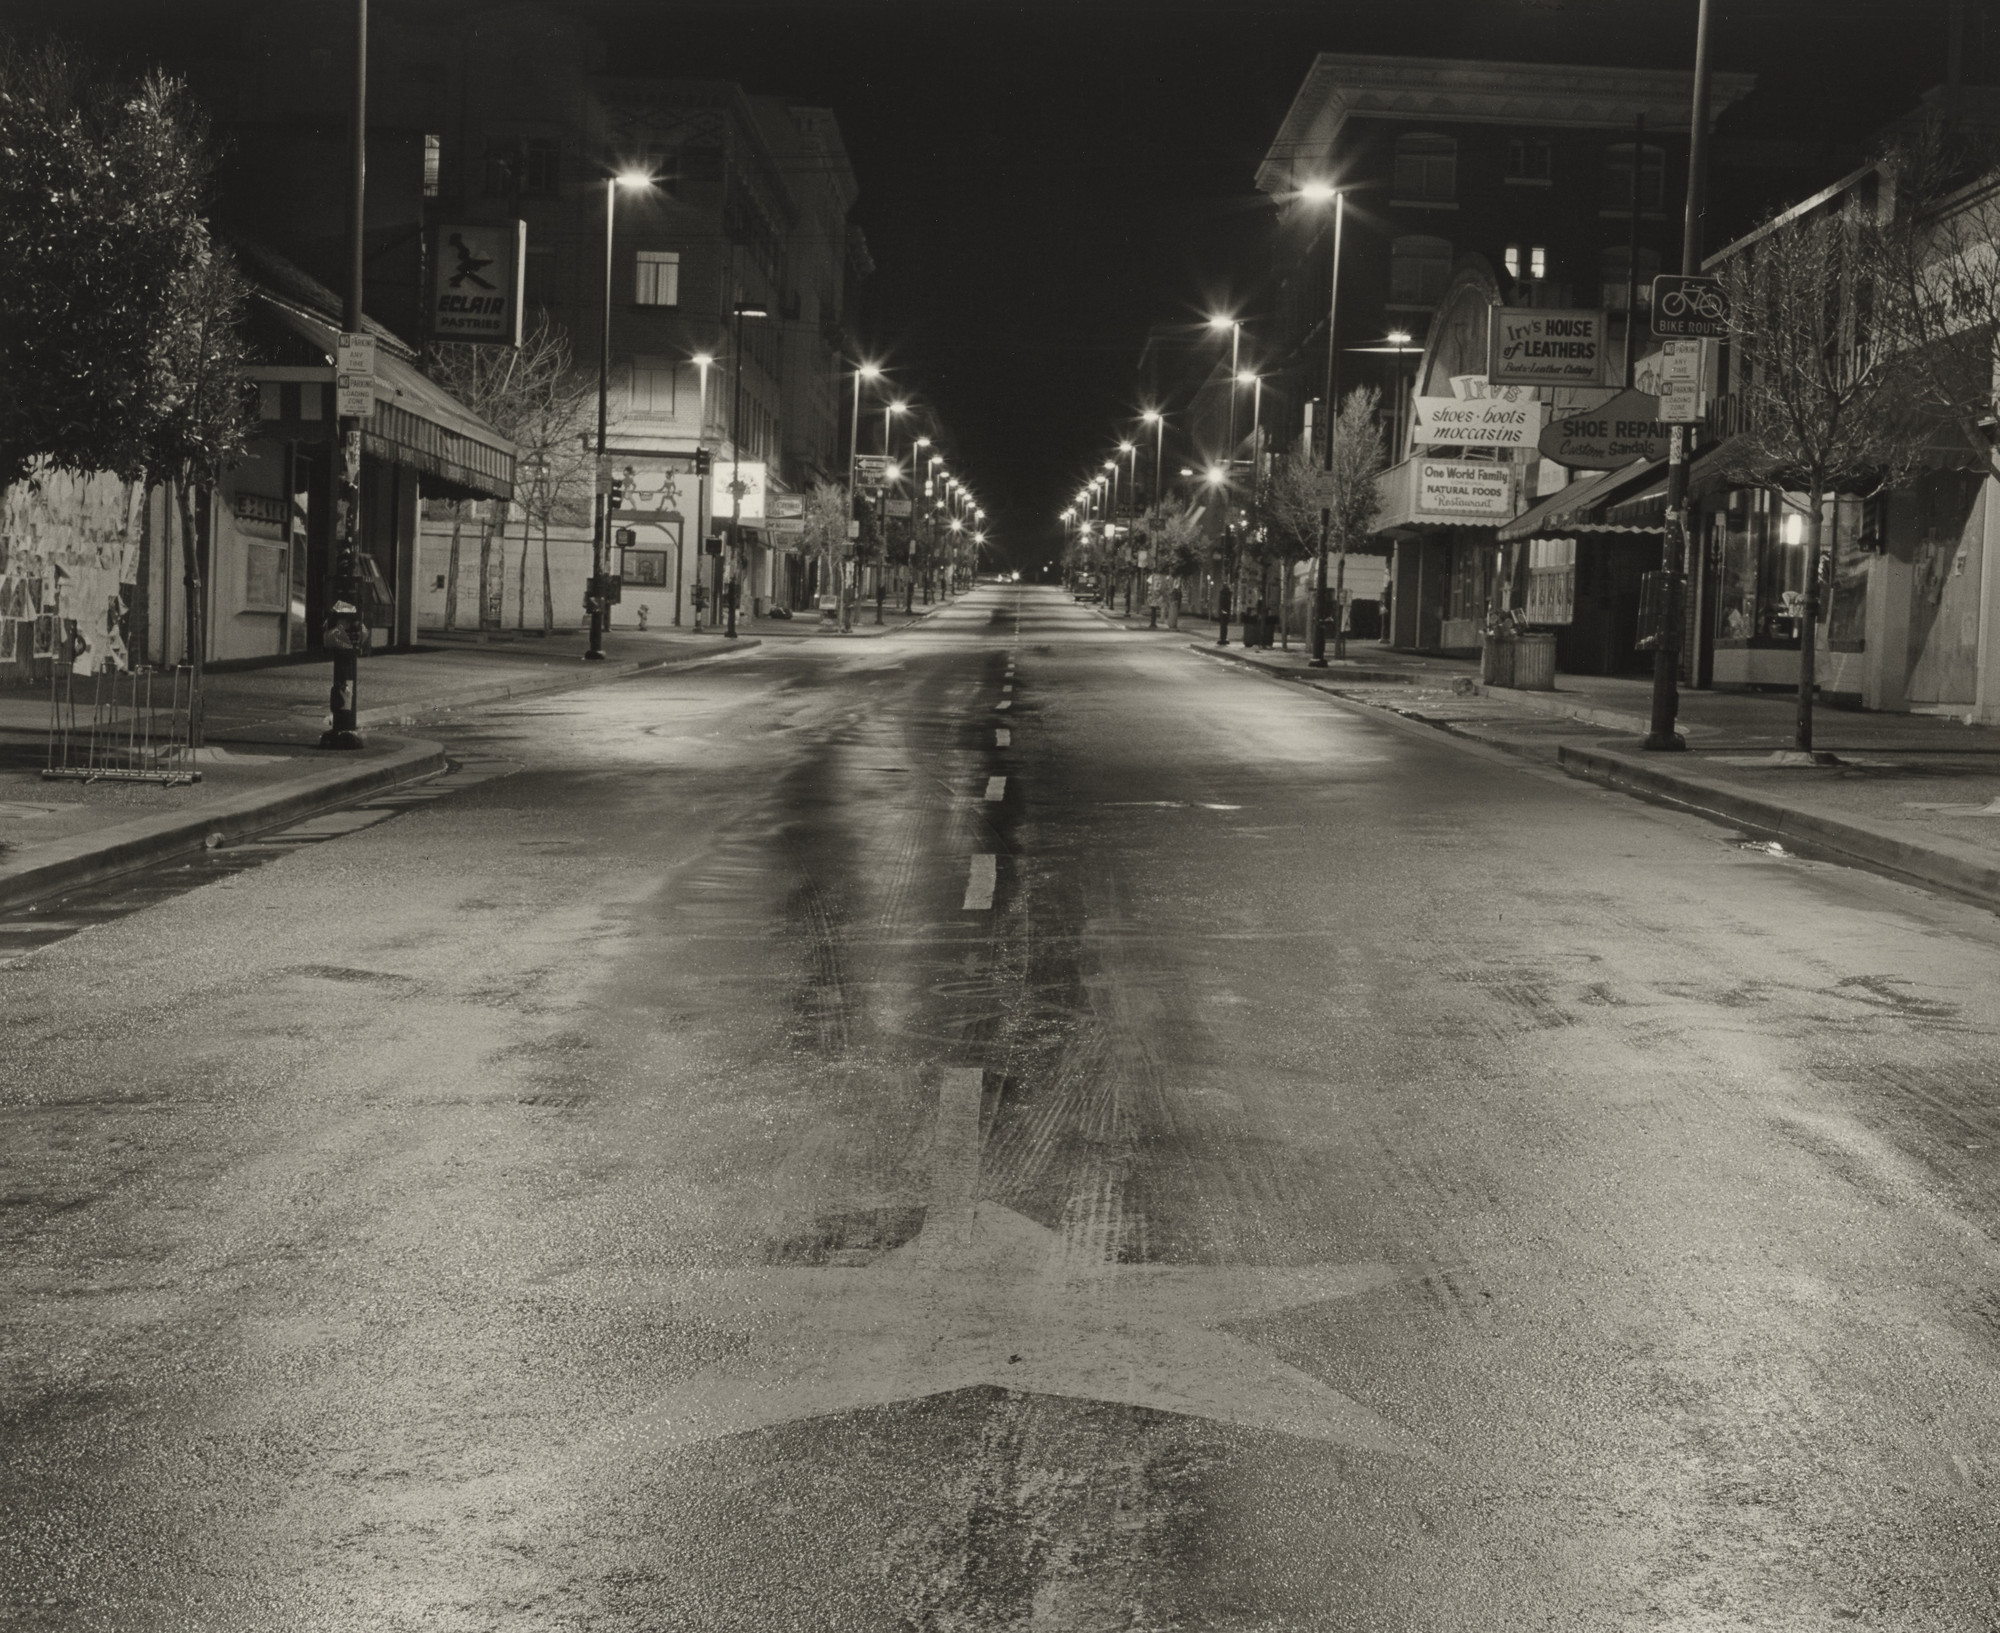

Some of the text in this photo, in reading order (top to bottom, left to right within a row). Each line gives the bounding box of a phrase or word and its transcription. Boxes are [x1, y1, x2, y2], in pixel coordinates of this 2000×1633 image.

[439, 295, 504, 314] ECLAIR
[441, 317, 501, 329] PASTRIES
[1507, 319, 1593, 340] Irv's HOUSE
[1660, 320, 1723, 334] BIKE ROUTE
[340, 335, 349, 346] NO
[1503, 341, 1597, 360] of LEATHERS
[340, 375, 349, 387] NO
[342, 390, 369, 398] LOADING
[1432, 405, 1526, 424] shoes boots
[1433, 426, 1523, 442] moccasins
[1563, 421, 1608, 438] SHOE
[1560, 440, 1606, 458] Custom
[1608, 441, 1655, 456] Sandals
[1425, 466, 1444, 478] One
[1447, 467, 1475, 480] World
[1478, 469, 1508, 485] Family
[1427, 485, 1502, 497] NATURAL FOODS
[1434, 494, 1493, 508] Restaurant
